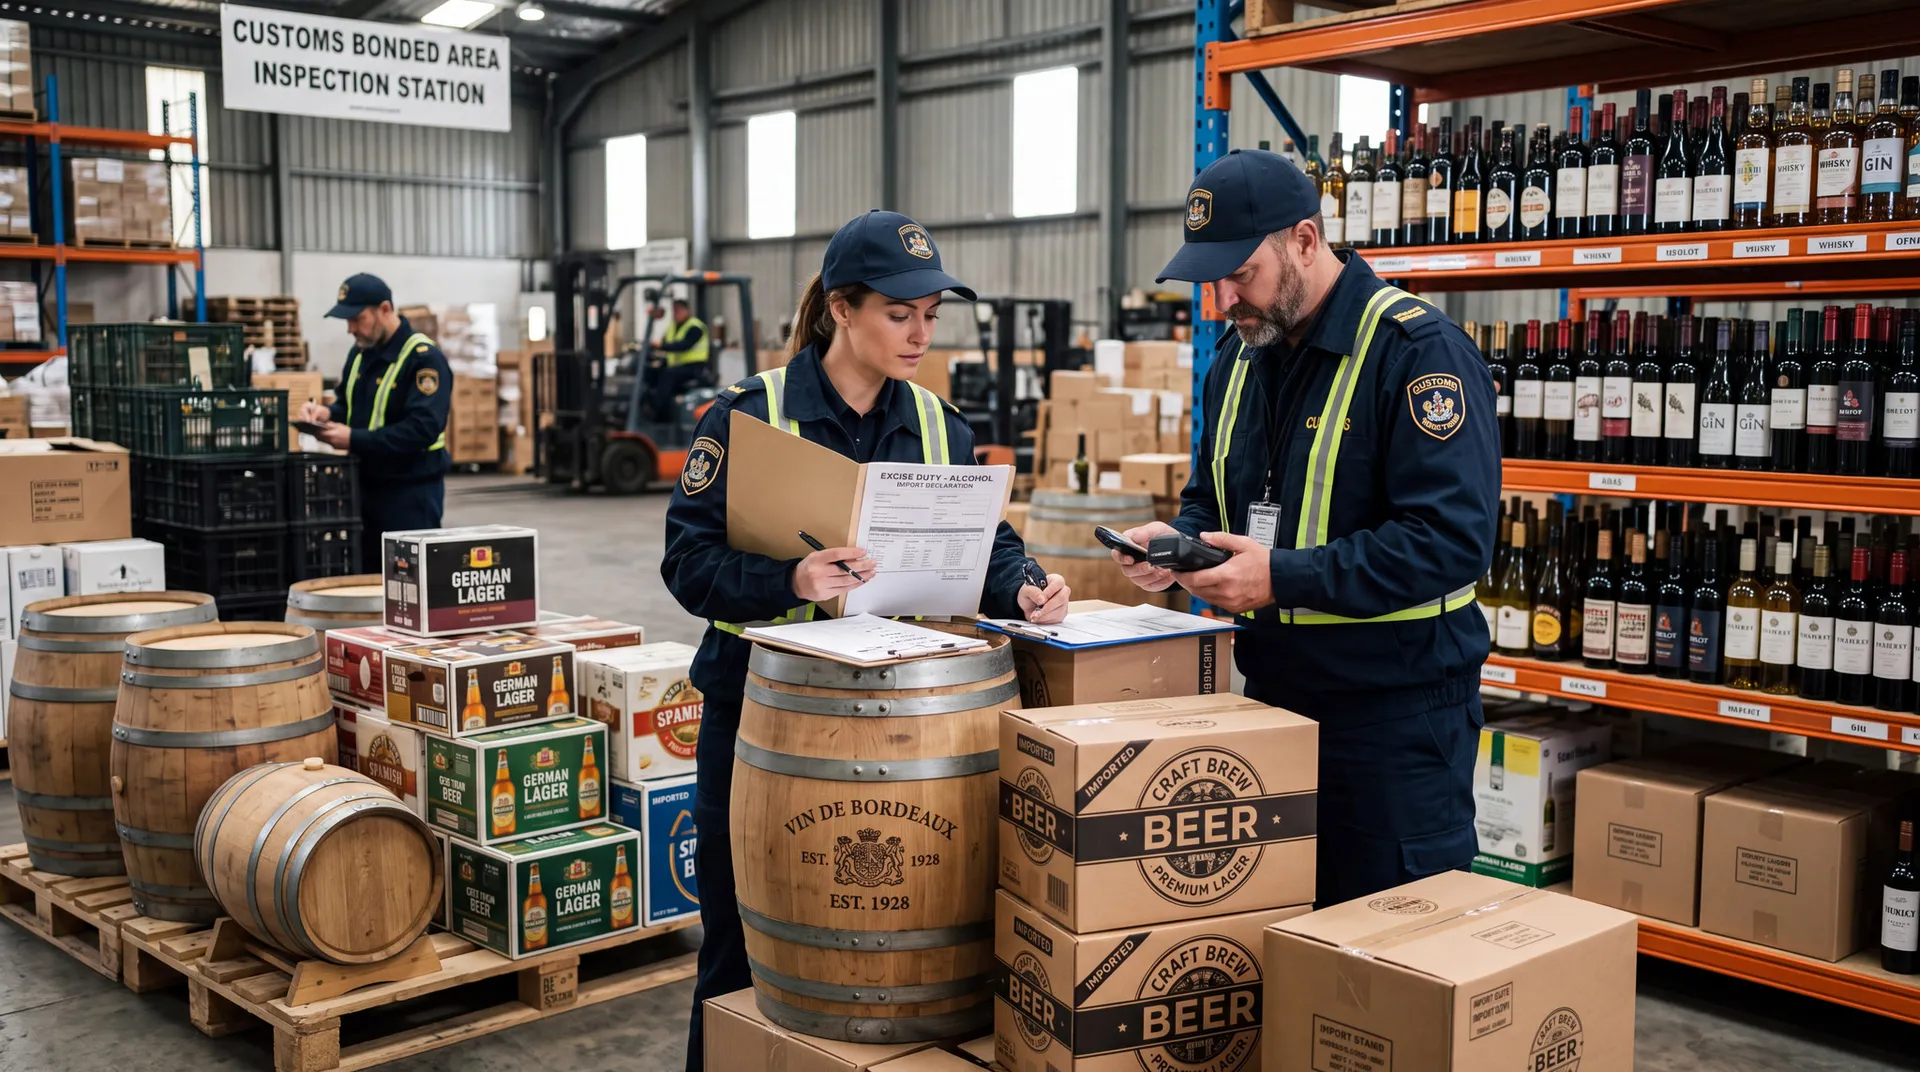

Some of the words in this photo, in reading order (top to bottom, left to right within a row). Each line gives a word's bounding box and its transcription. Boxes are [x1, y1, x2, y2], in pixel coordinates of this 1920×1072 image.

[233, 19, 344, 53] CUSTOMS
[353, 33, 440, 64] BONDED
[447, 44, 500, 71] AREA
[254, 60, 390, 96] INSPECTION
[398, 76, 485, 105] STATION
[1777, 163, 1805, 173] WHISKY
[1864, 156, 1893, 172] GIN
[1819, 240, 1855, 250] WHISKY
[880, 472, 914, 481] EXCISE
[916, 473, 942, 482] DUTY
[949, 474, 994, 482] ALCOHOL
[896, 481, 924, 489] IMPORT
[451, 567, 512, 588] GERMAN
[458, 584, 506, 604] LAGER
[493, 674, 538, 694] GERMAN
[496, 688, 536, 708] LAGER
[1018, 737, 1055, 763] IMPORTED
[523, 767, 570, 788] GERMAN
[1020, 771, 1036, 789] CRAFT
[1083, 746, 1136, 799] IMPORTED
[1151, 757, 1202, 803] CRAFT
[1206, 756, 1254, 793] BREW
[442, 786, 463, 806] BEER
[524, 781, 569, 805] LAGER
[652, 791, 690, 806] IMPORTED
[784, 808, 817, 837] VIN
[818, 800, 847, 822] DE
[850, 799, 960, 841] BORDEAUX
[1012, 792, 1058, 842] BEER
[1144, 804, 1259, 851] BEER
[800, 850, 829, 866] EST.
[910, 853, 941, 868] 1928
[1152, 865, 1209, 896] PREMIUM
[1213, 854, 1251, 892] LAGER
[555, 877, 602, 900] GERMAN
[469, 897, 491, 918] BEER
[556, 891, 602, 917] LAGER
[829, 893, 866, 911] EST.
[871, 895, 911, 911] 1928
[1084, 939, 1135, 991] IMPORTED
[1151, 946, 1200, 993] CRAFT
[1204, 944, 1252, 979] BREW
[1009, 974, 1056, 1032] BEER
[1143, 989, 1257, 1041] BEER
[1319, 1023, 1353, 1042] IMPORT
[1537, 1015, 1558, 1047] CRAFT
[1558, 1013, 1578, 1032] BREW
[1535, 1038, 1577, 1072] BEER
